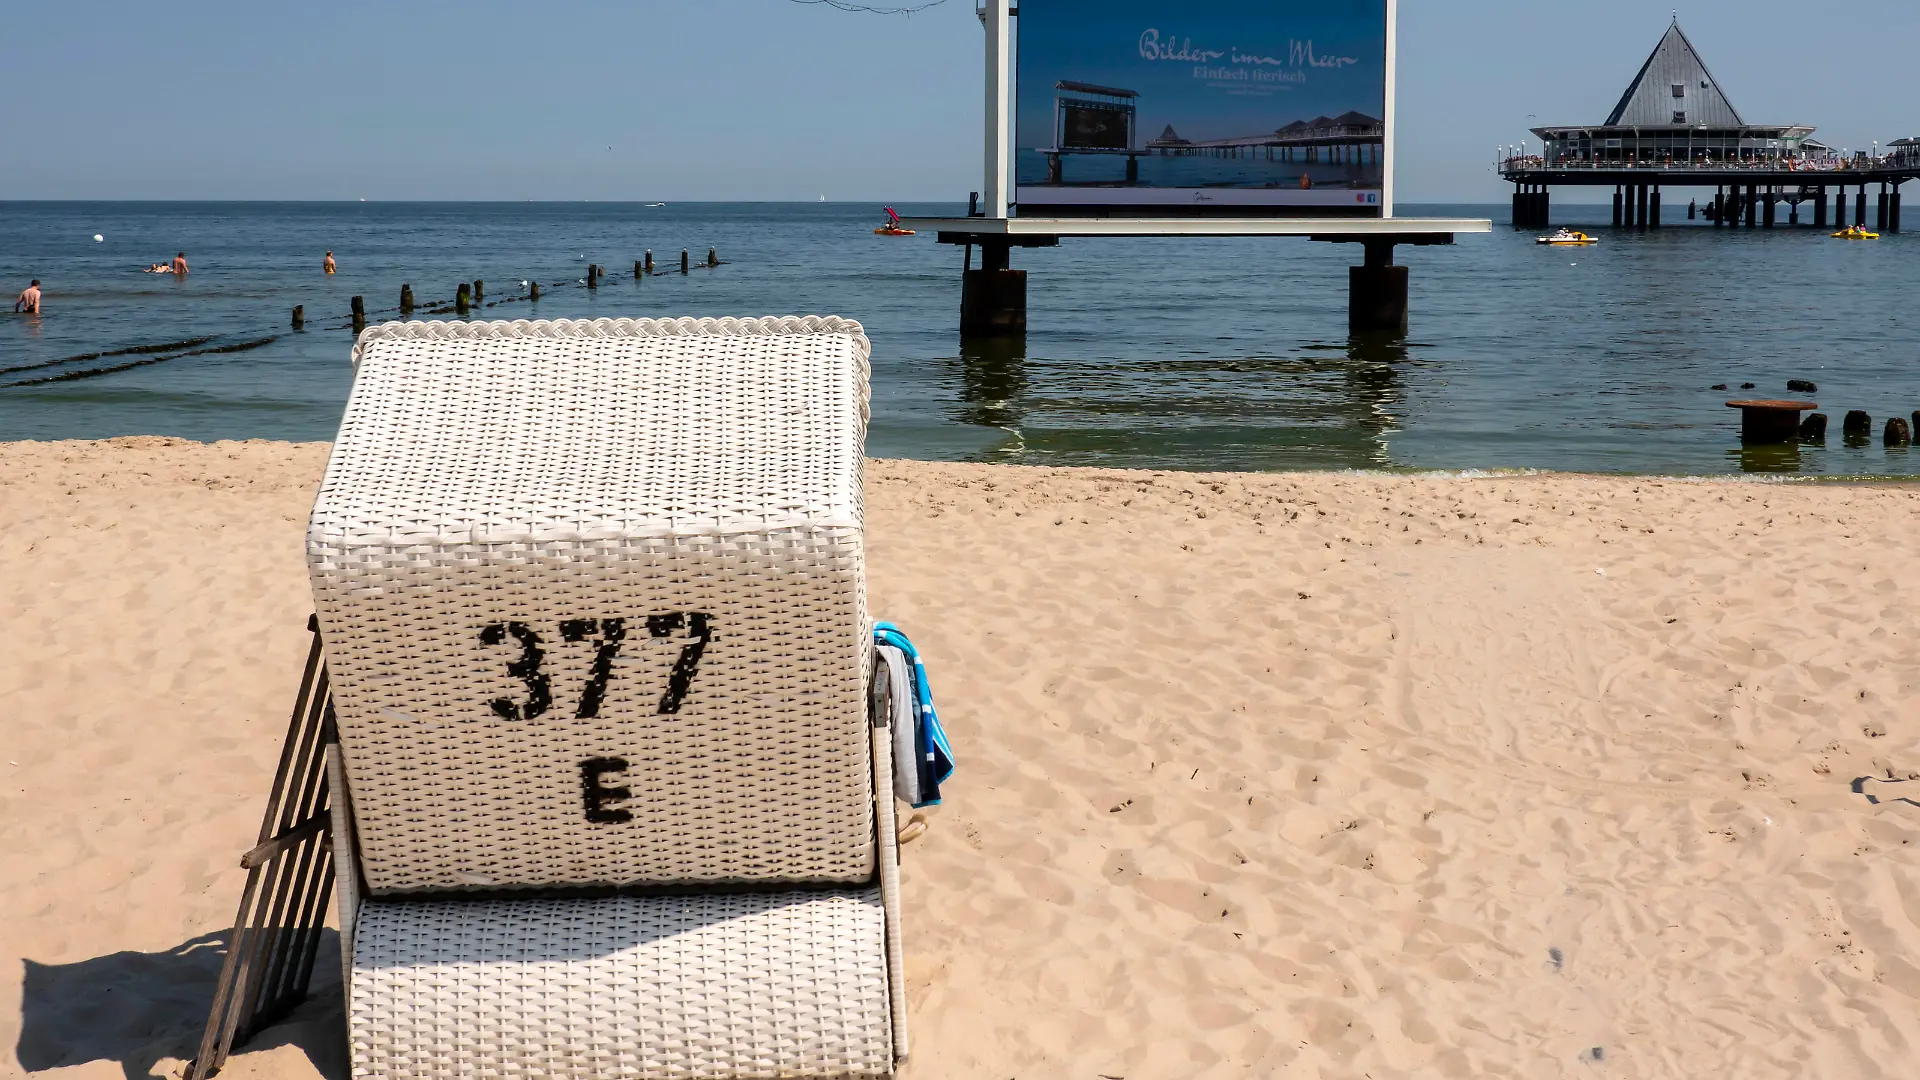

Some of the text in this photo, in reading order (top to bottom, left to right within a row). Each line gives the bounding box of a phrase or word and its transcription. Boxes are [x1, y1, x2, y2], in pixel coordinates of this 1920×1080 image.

[1138, 28, 1359, 69] Bilder im Meer
[1193, 65, 1249, 81] Einfach
[479, 612, 720, 721] 377
[577, 756, 634, 824] E
